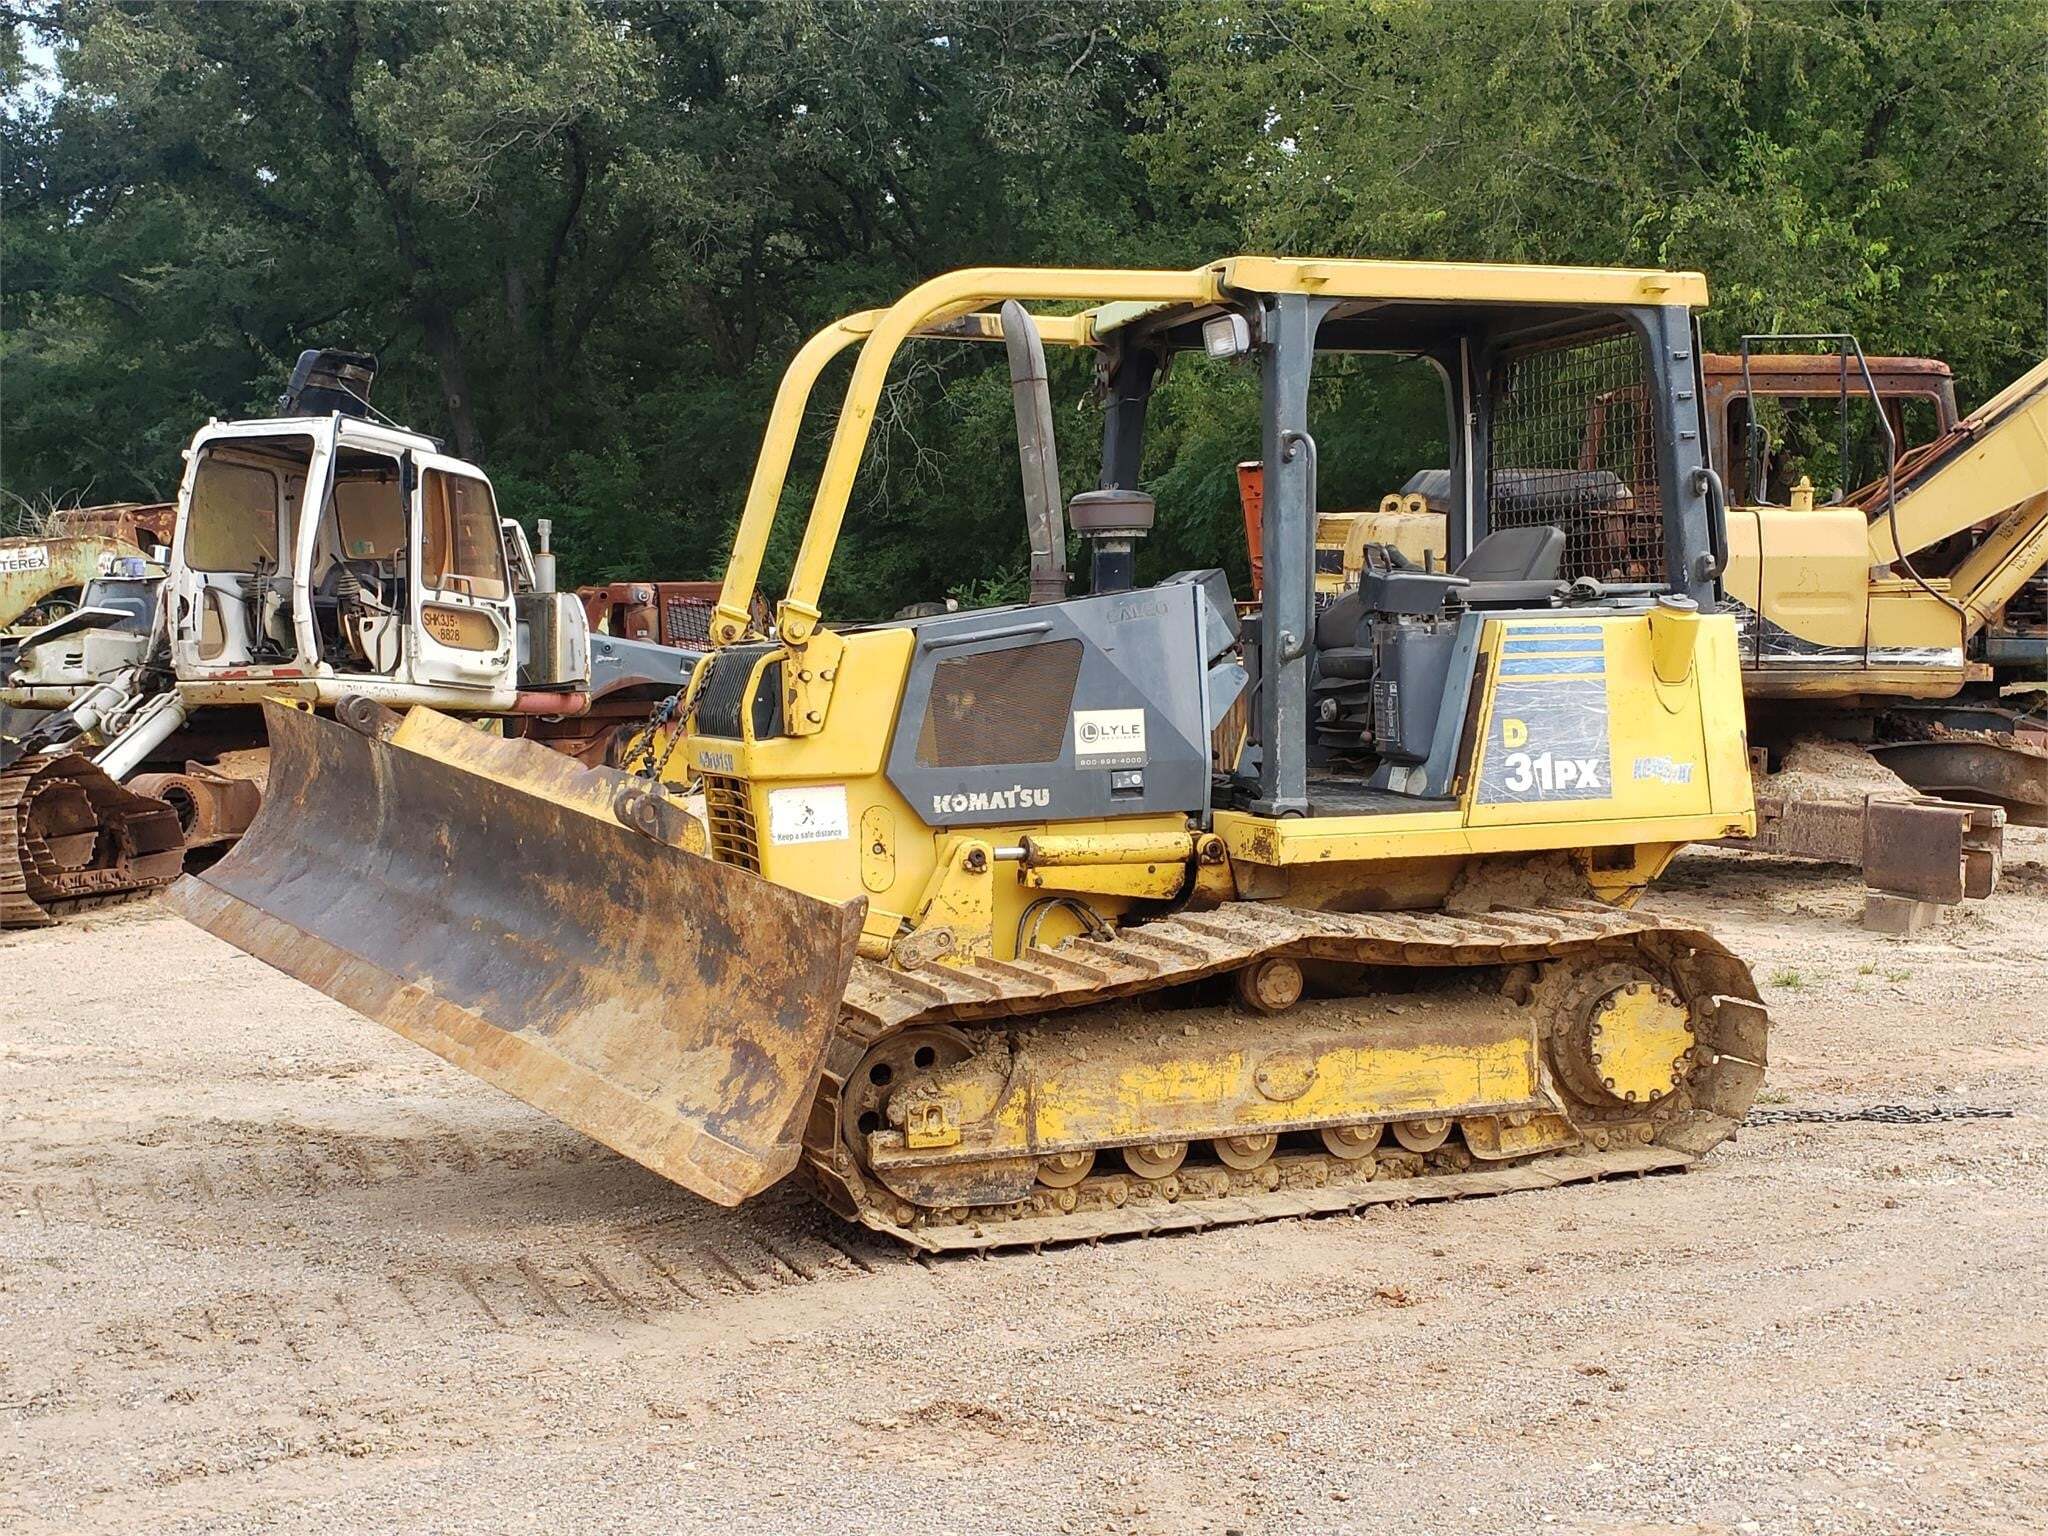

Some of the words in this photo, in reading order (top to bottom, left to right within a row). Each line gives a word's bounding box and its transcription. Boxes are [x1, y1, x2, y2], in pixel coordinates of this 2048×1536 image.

[0, 558, 47, 570] TEREX
[1101, 724, 1141, 735] LYLE
[1503, 719, 1528, 748] D
[933, 785, 1050, 813] KOMATSU
[777, 832, 794, 841] Keep
